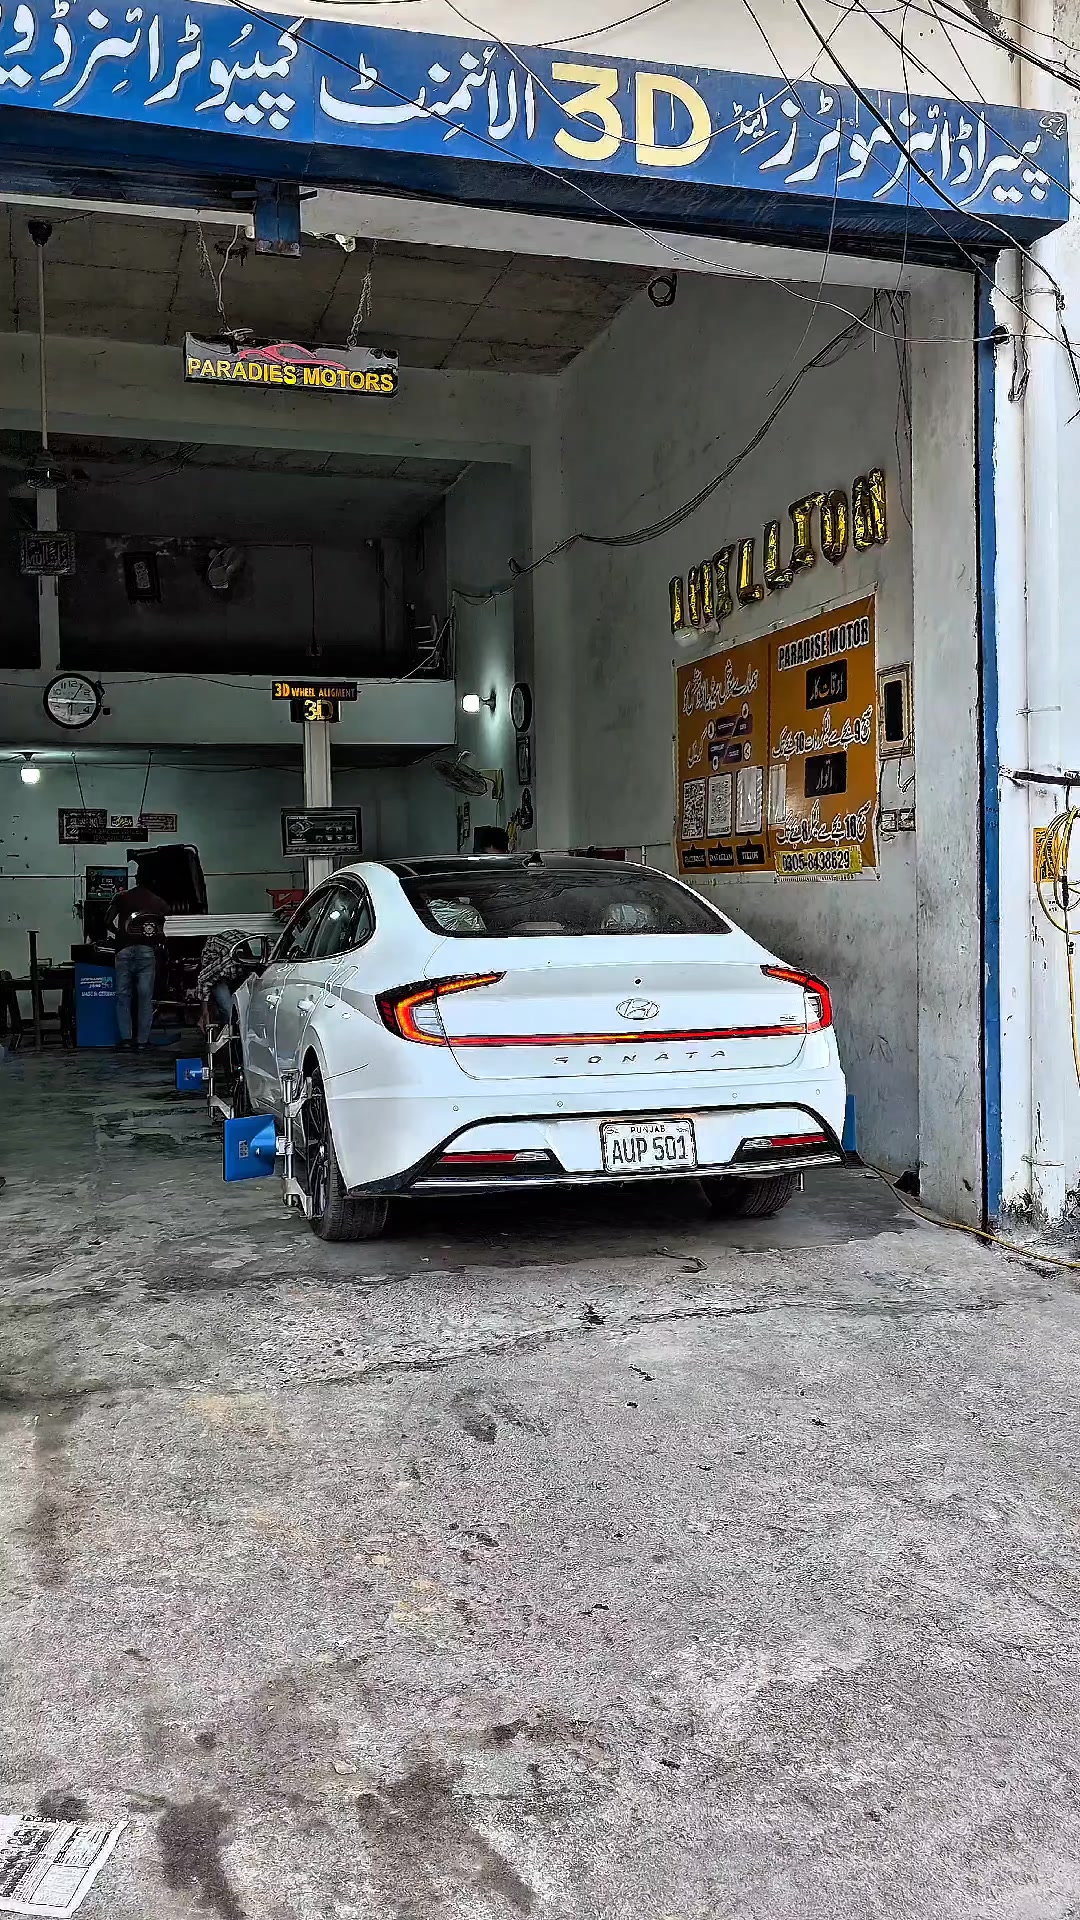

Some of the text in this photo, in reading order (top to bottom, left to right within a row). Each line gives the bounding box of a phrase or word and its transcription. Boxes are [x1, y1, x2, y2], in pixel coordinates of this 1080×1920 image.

[551, 62, 712, 167] 3D
[187, 358, 394, 392] PARADIES MOTORS
[778, 616, 870, 672] PARADISE MOTOR
[274, 683, 355, 698] 3D WHEEL ALIGMENT
[304, 699, 334, 720] 3D
[794, 731, 805, 754] 10
[853, 718, 861, 743] 9
[801, 819, 809, 844] 8
[553, 1050, 727, 1064] SONATA
[630, 1125, 666, 1134] PUNJAB
[612, 1135, 687, 1164] AUP 501
